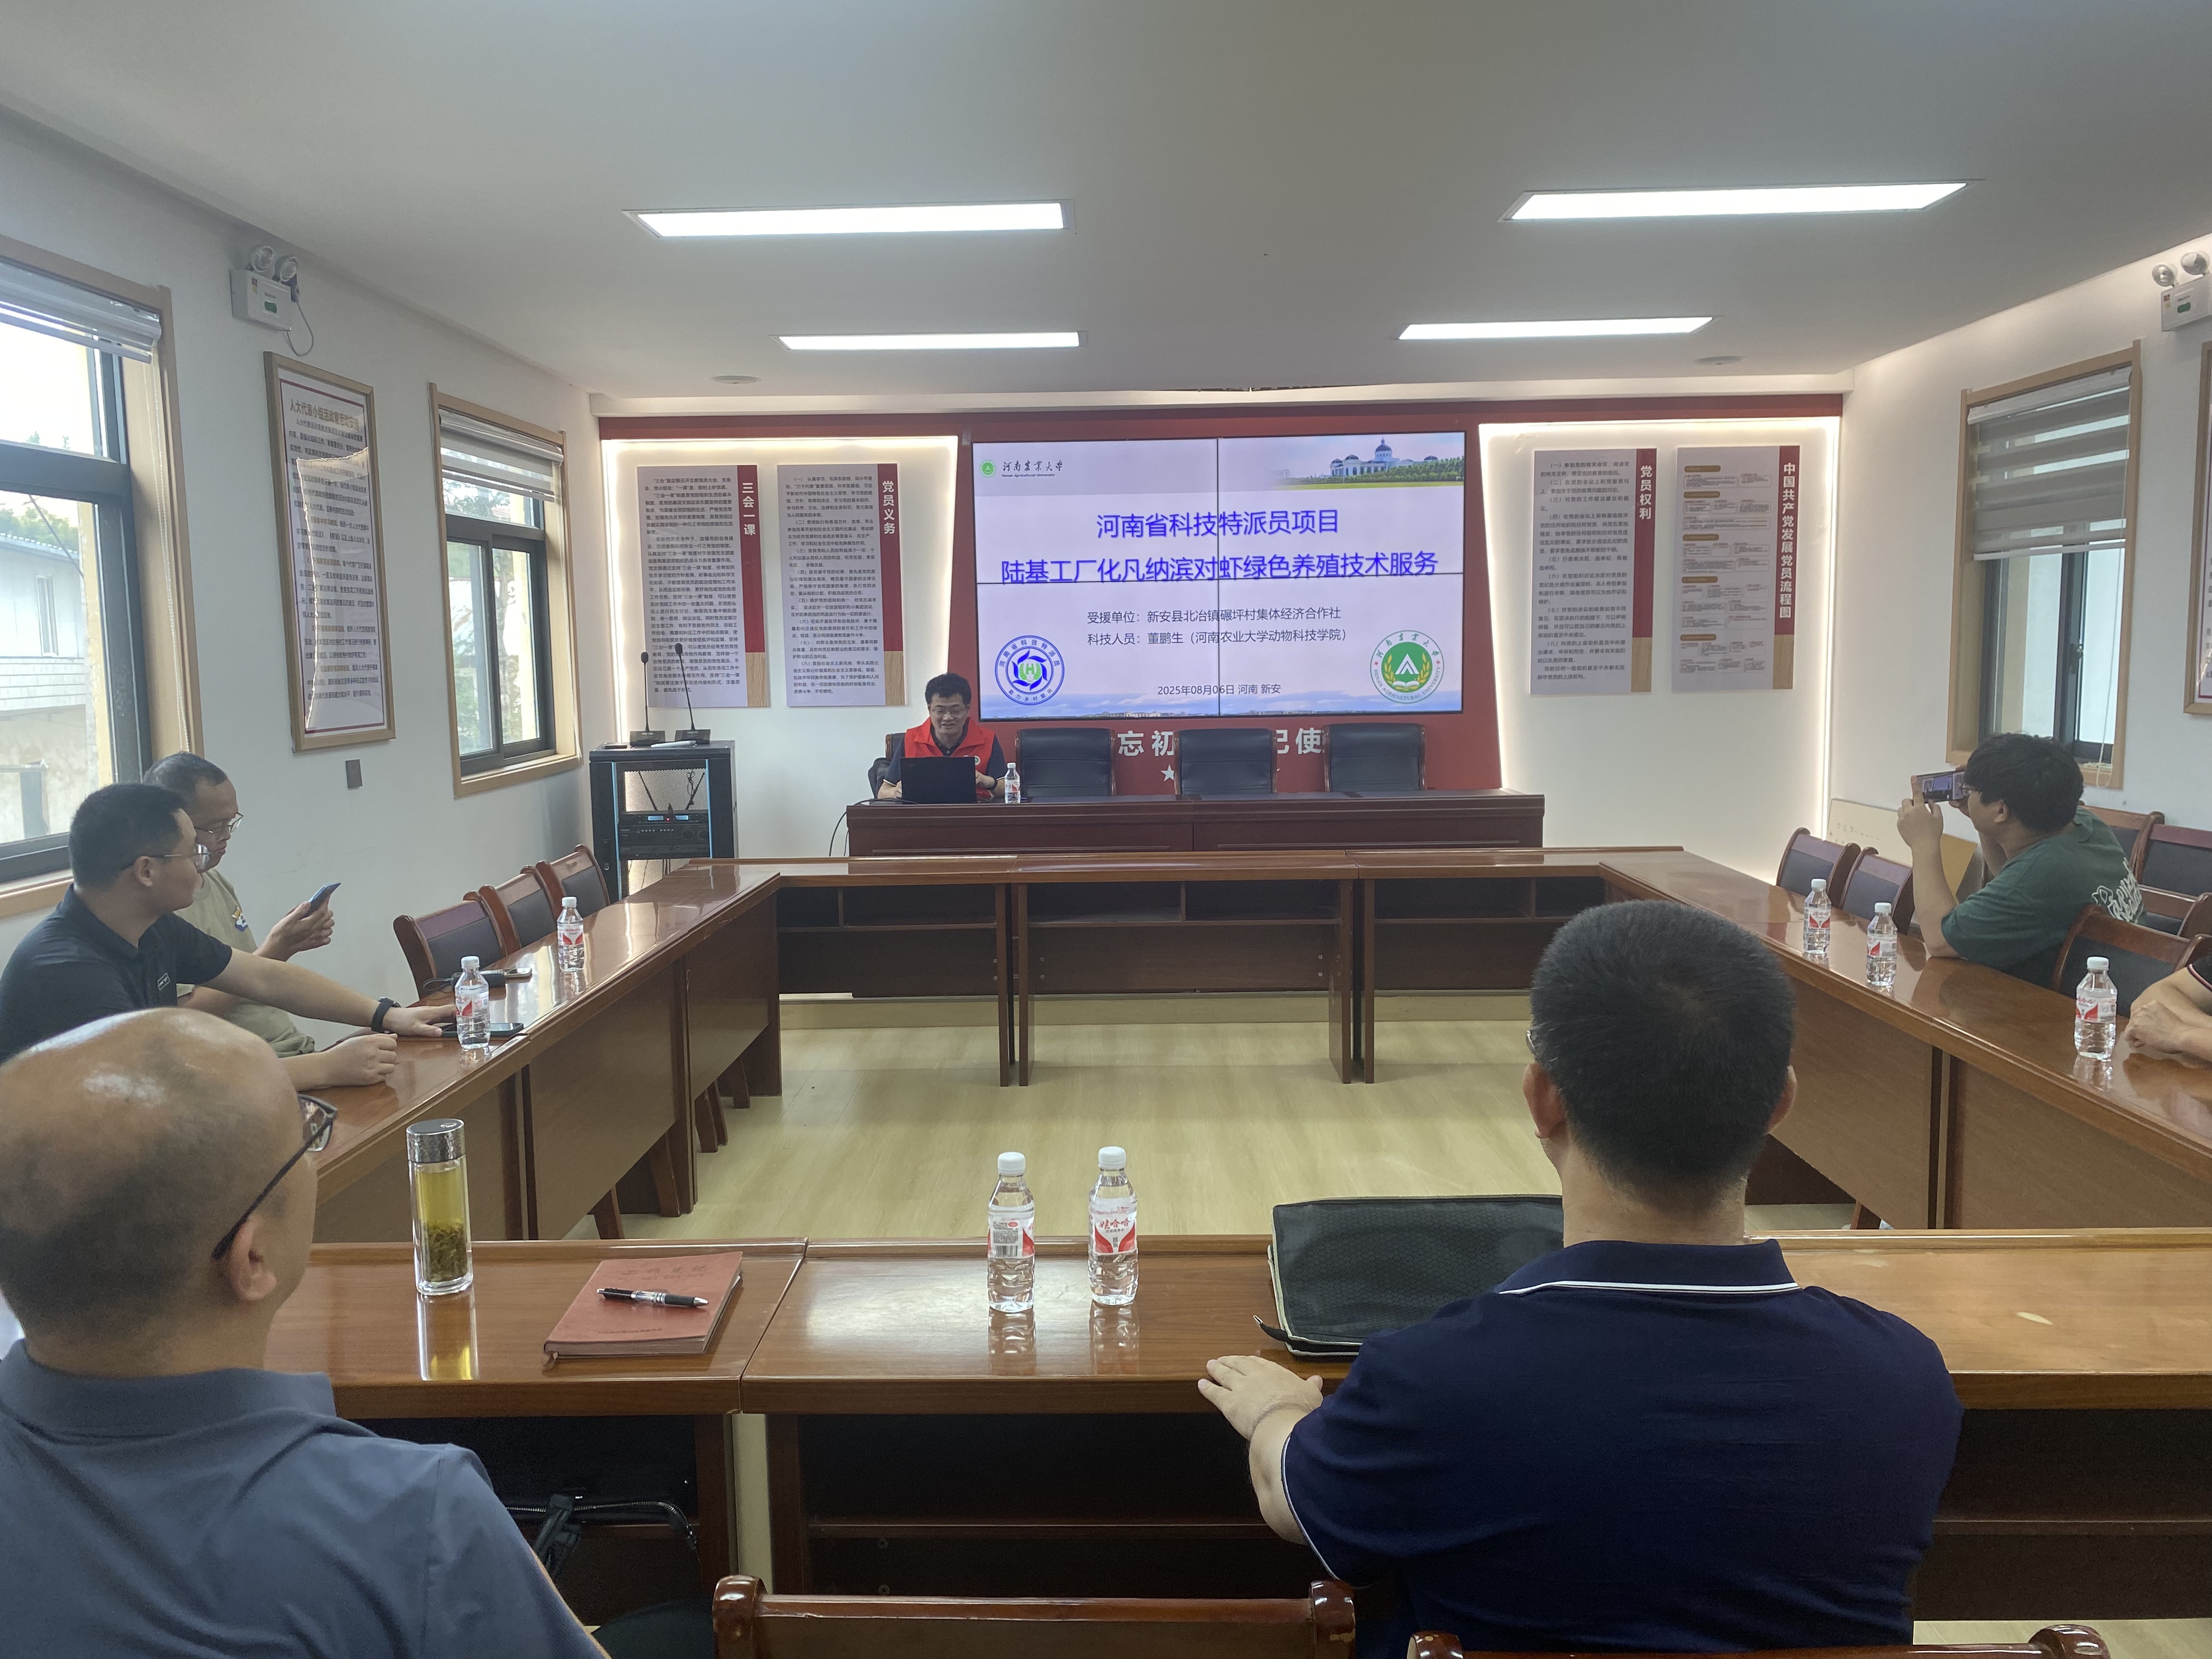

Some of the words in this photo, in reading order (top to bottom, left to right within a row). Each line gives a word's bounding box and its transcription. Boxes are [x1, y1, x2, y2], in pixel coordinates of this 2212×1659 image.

[882, 481, 895, 534] 党员义务
[1639, 465, 1652, 520] 党员权利
[742, 482, 757, 536] 三会一课
[1097, 509, 1339, 539] 河南省科技特派员项目
[1780, 463, 1796, 618] 中国共产党发展党员流程图
[1001, 550, 1438, 584] 陆基工厂化凡纳滨对虾绿色养殖技术服务
[1000, 639, 1060, 667] 河南省科技特派员
[1026, 663, 1035, 675] H
[1374, 669, 1383, 687] HENAN
[1382, 687, 1421, 701] AGRICULTURAL
[1422, 667, 1441, 695] UNIVERSITY
[1008, 689, 1053, 702] 助力乡村振兴
[1157, 684, 1234, 696] 2025年08月06日
[1238, 683, 1257, 695] 河南
[1261, 683, 1280, 694] 新安
[1117, 730, 1174, 757] 忘初
[1099, 1217, 1130, 1229] 娃哈哈
